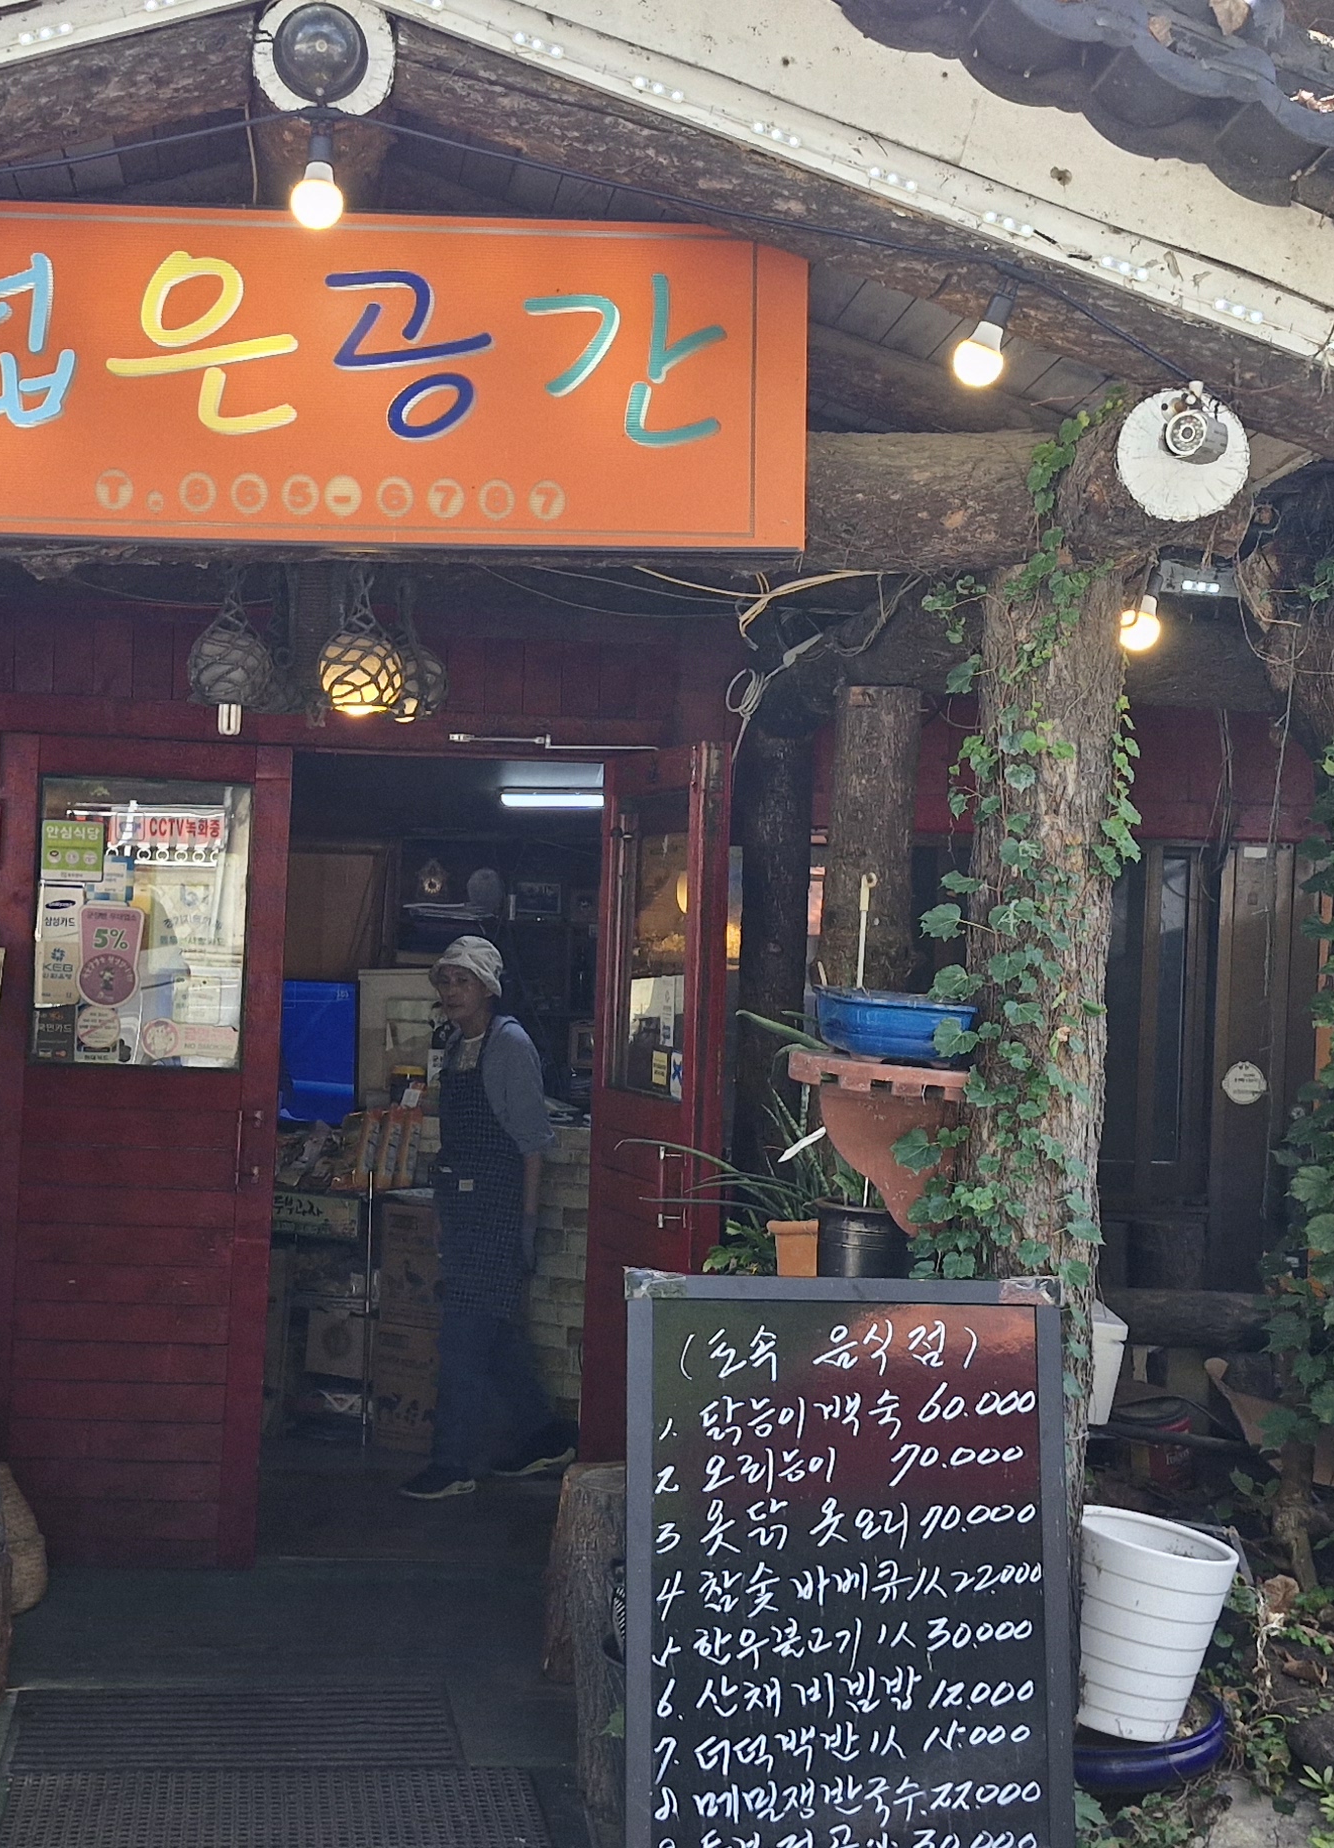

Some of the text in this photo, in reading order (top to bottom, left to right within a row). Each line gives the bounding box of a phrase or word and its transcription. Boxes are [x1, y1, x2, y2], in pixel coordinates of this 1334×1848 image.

[46, 826, 100, 840] 안심식당
[44, 917, 75, 927] 삼성카드
[94, 929, 128, 949] 5%
[43, 963, 73, 972] KEB
